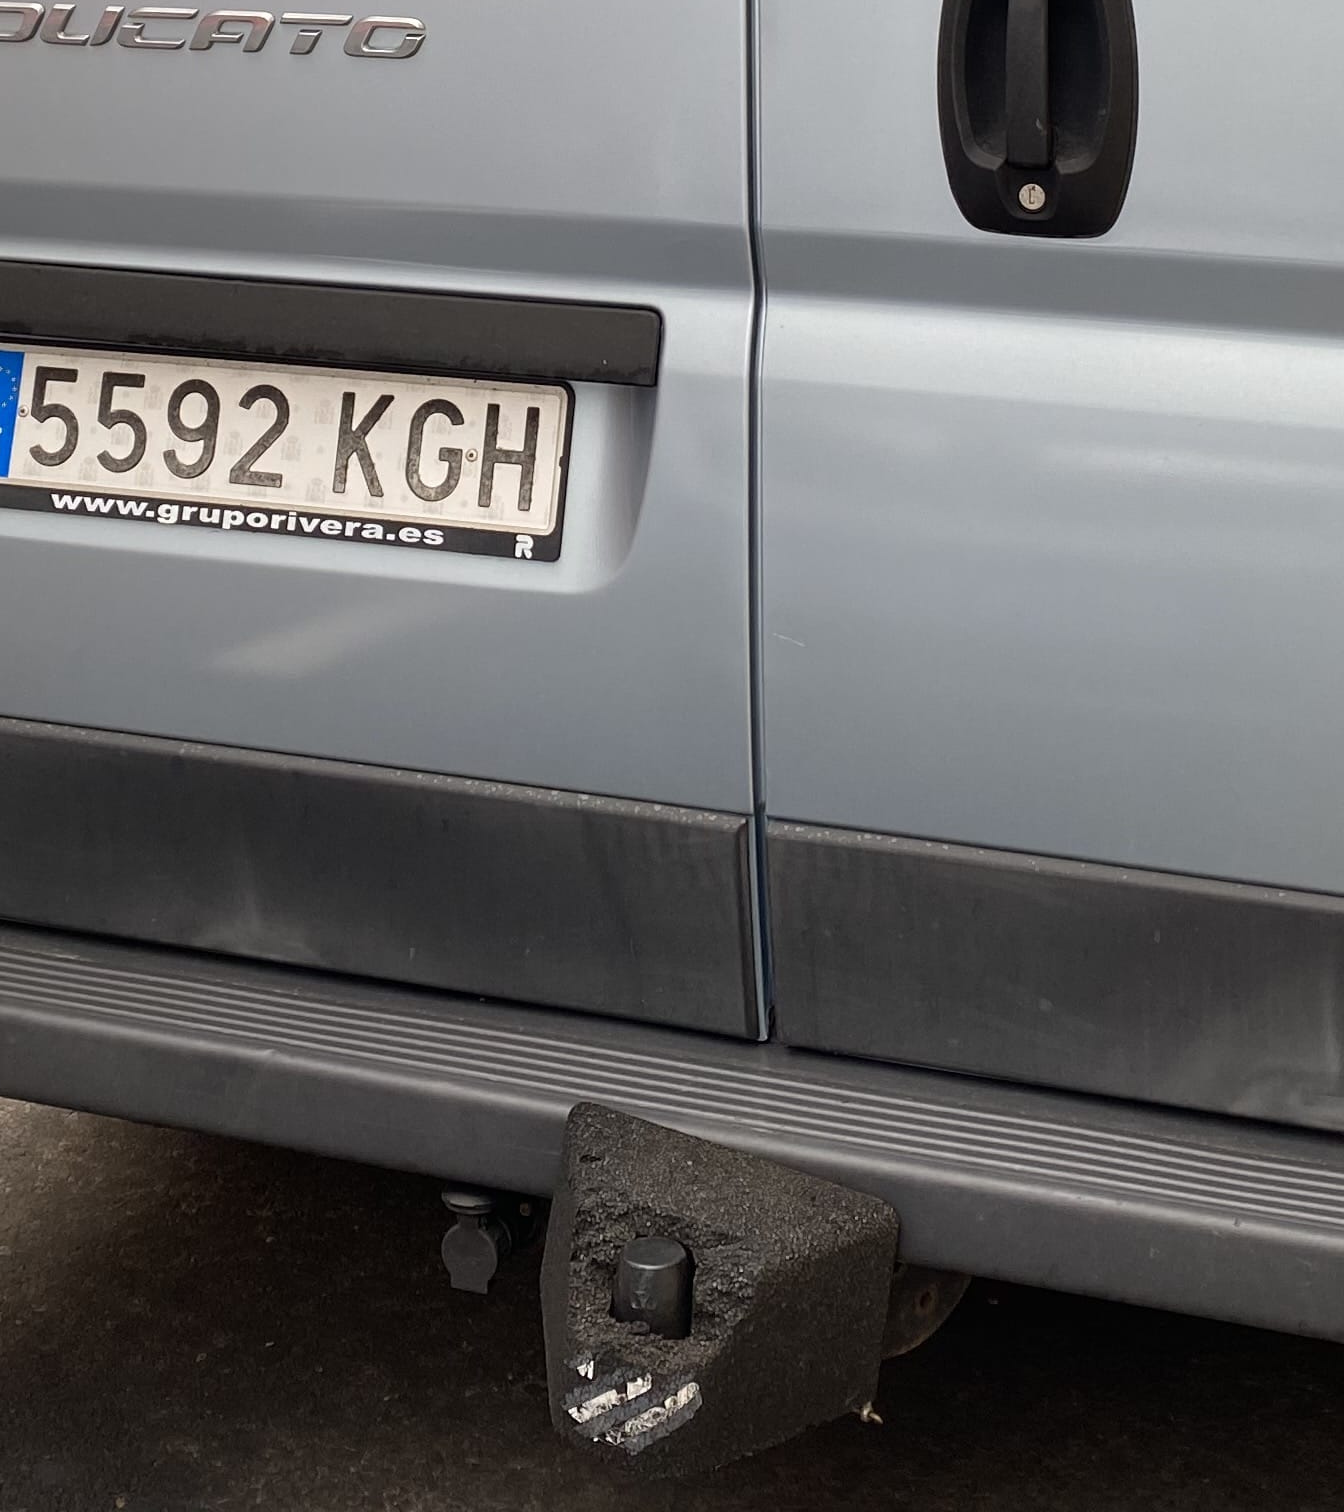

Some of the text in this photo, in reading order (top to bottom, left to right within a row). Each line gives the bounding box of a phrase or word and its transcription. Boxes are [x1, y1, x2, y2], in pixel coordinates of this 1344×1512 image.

[29, 365, 540, 511] 5592 KGH
[50, 492, 444, 546] www.gruporivera.es
